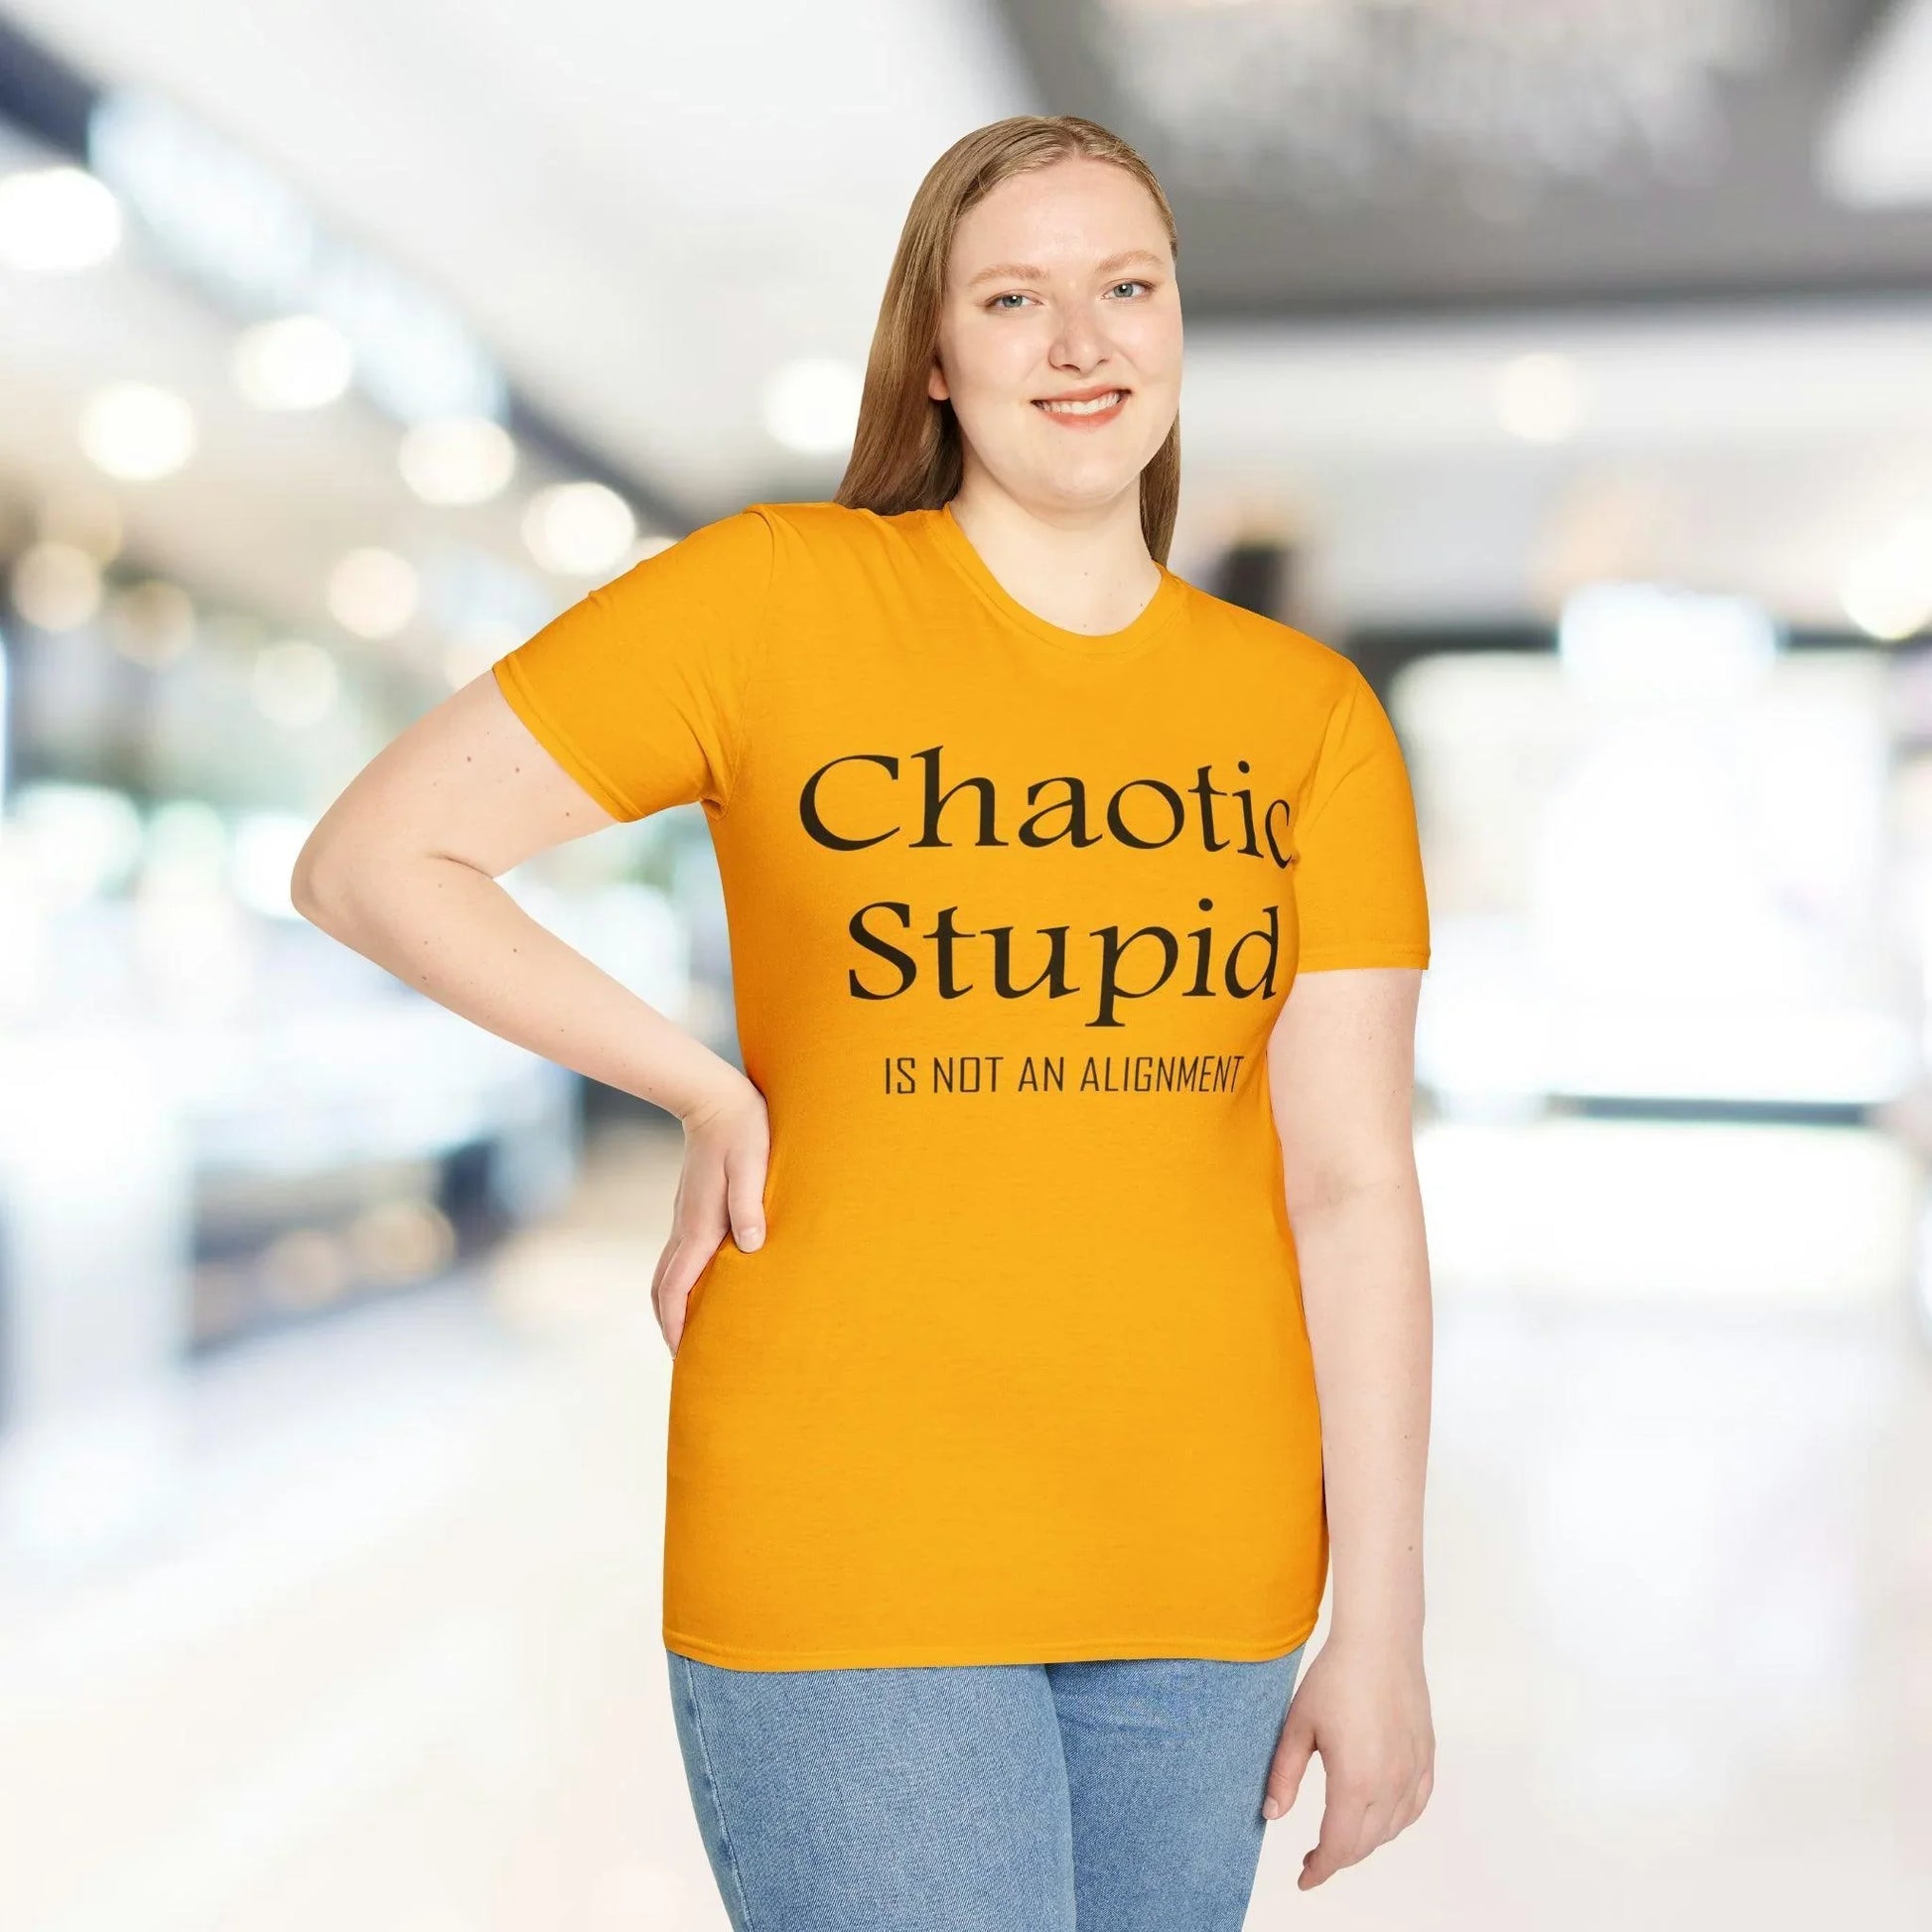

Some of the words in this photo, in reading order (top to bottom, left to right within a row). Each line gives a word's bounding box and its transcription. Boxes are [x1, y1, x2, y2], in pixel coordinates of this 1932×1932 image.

[798, 745, 1293, 870] Chaotic
[848, 897, 1279, 1028] Stupid
[885, 1056, 916, 1095] IS
[932, 1056, 1004, 1093] NOT
[1017, 1055, 1064, 1092] AN
[1079, 1055, 1244, 1093] ALIGNMENT
